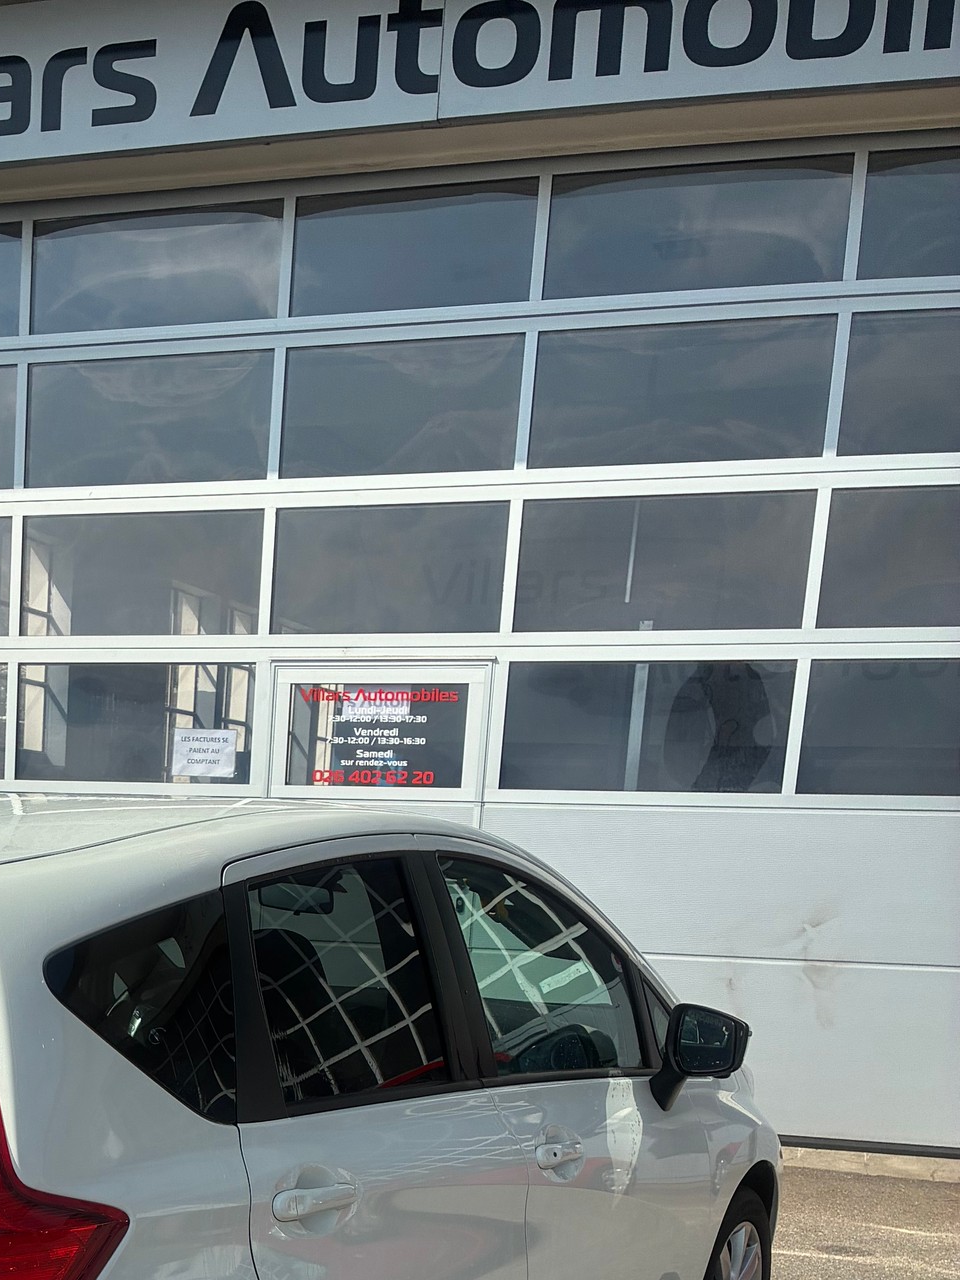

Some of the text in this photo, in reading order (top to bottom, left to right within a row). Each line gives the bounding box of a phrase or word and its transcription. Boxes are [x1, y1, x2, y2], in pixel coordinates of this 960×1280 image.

[422, 558, 609, 606] Vilars
[301, 688, 458, 703] Villars Automobiles
[348, 706, 408, 715] Lundi-Jeudi
[354, 728, 398, 736] Vendredi
[378, 737, 426, 745] 13:30-16:30
[356, 749, 393, 758] Samedi
[312, 770, 434, 784] 026 402 62 20
